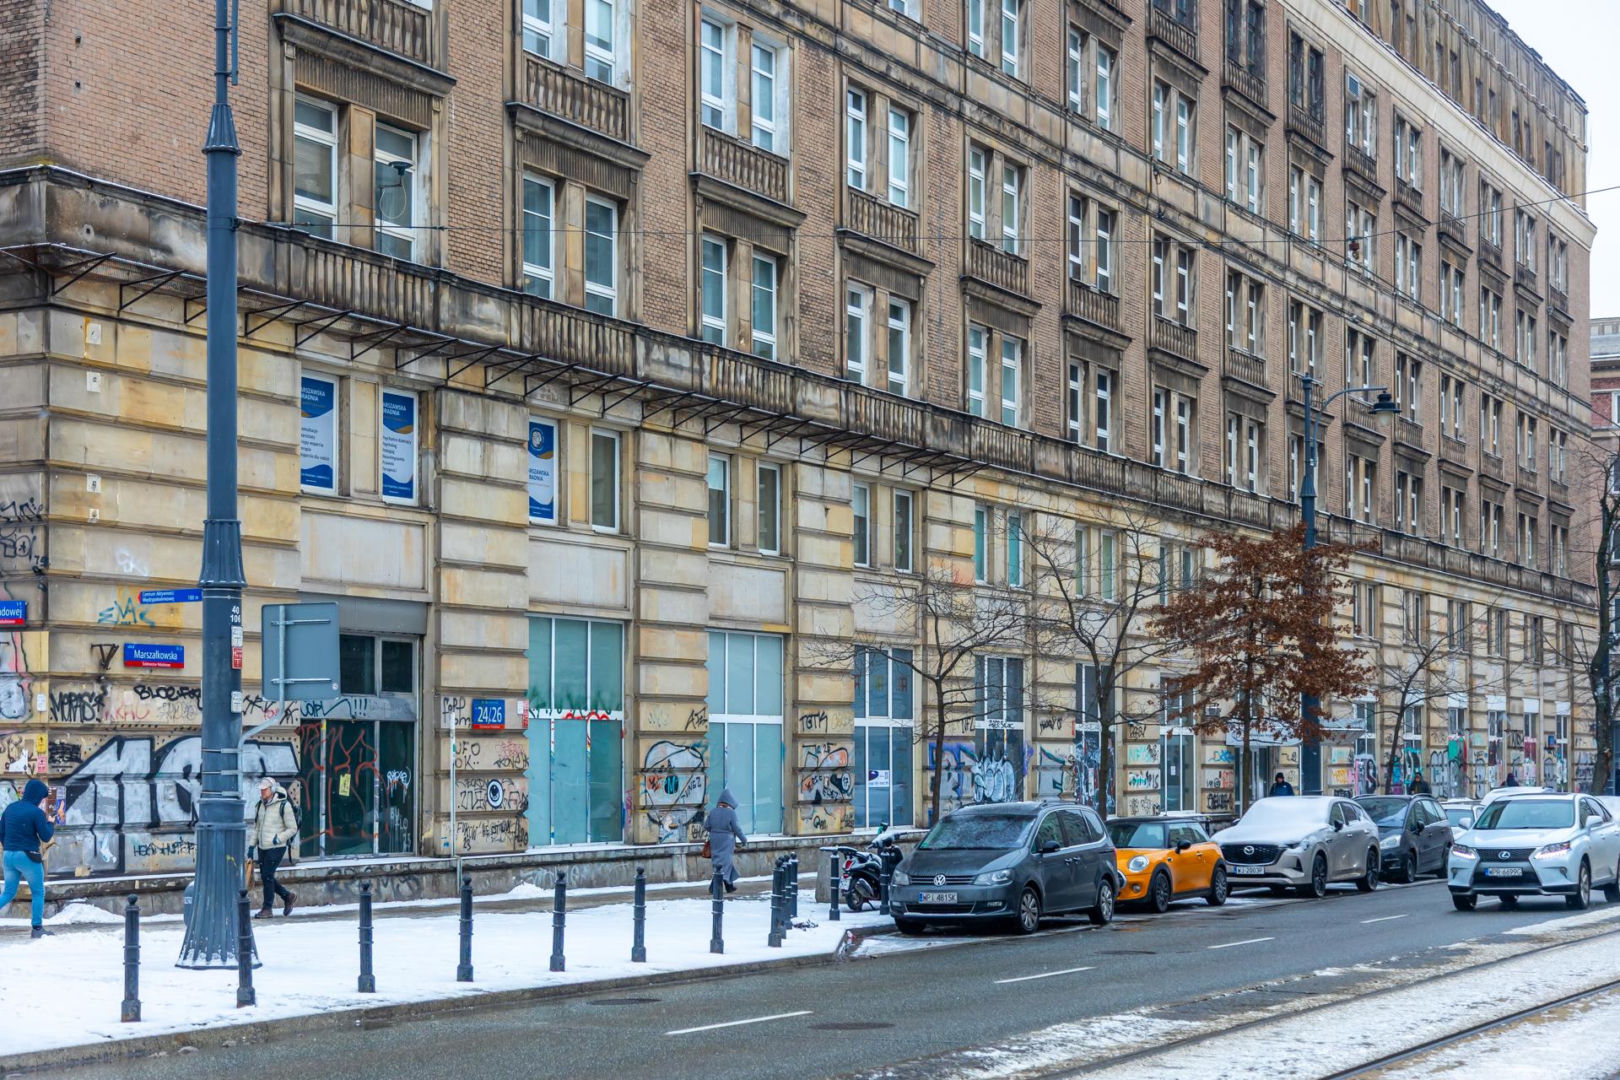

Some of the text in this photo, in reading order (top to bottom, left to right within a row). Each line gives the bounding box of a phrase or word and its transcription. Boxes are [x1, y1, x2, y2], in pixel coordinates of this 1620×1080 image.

[0, 606, 22, 618] dowej
[232, 606, 240, 614] 40
[134, 650, 178, 660] Marszałkowska
[478, 706, 502, 723] 24/26
